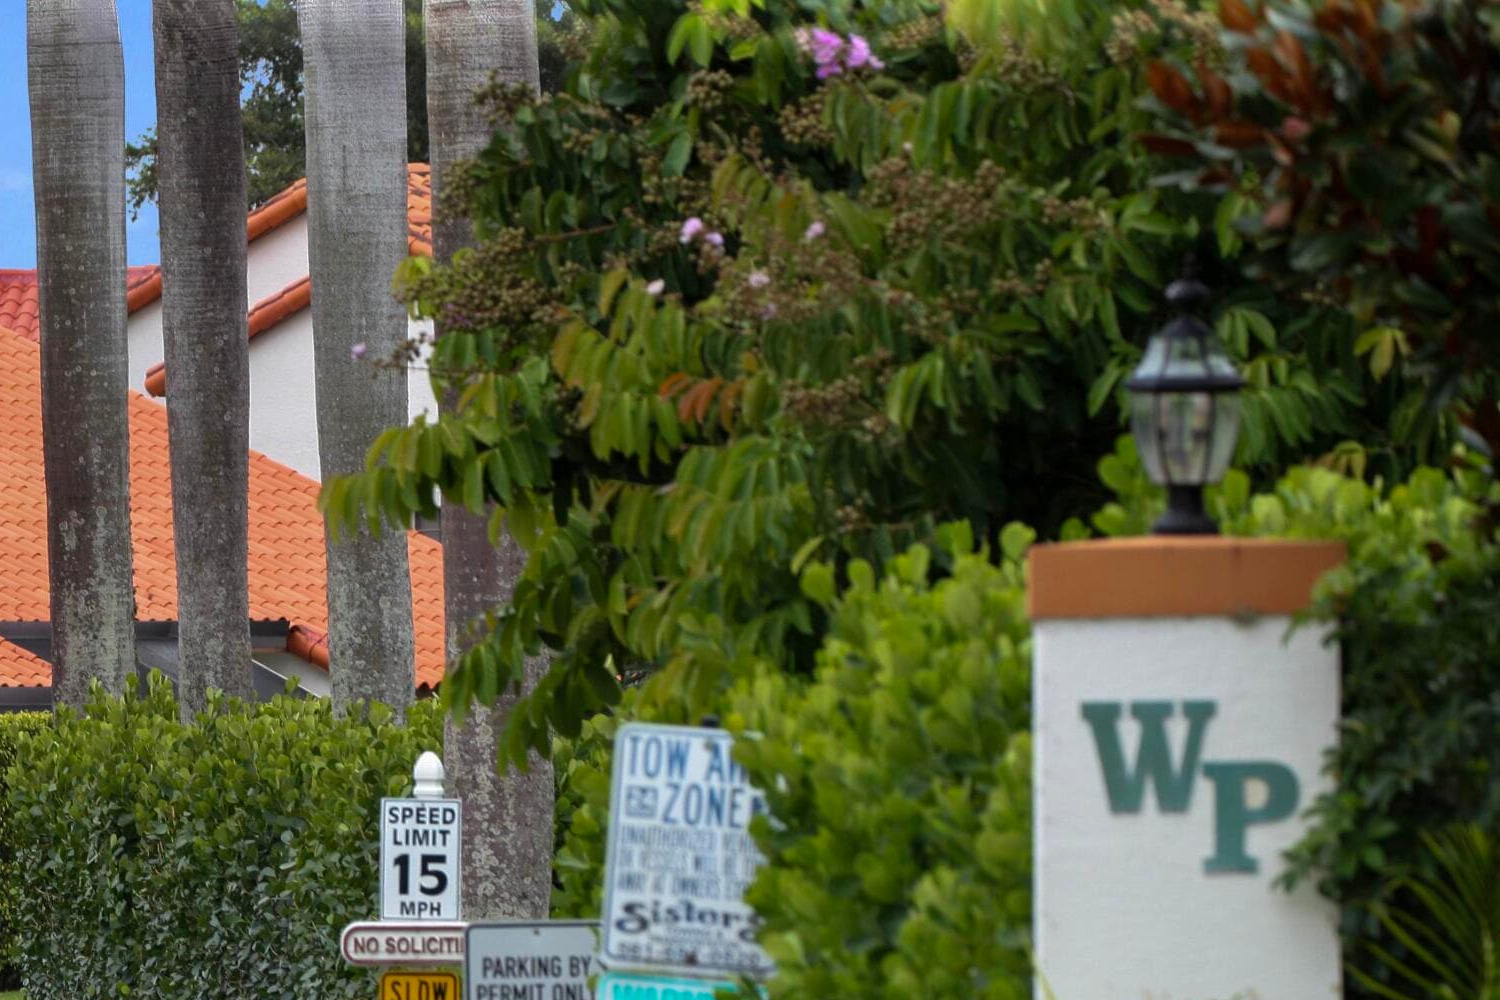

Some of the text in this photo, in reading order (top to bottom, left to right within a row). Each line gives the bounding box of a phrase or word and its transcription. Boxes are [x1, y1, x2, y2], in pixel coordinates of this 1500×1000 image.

[628, 735, 691, 779] TOW
[388, 806, 456, 825] SPEED
[662, 782, 744, 829] ZONE
[392, 828, 451, 847] LIMIT
[393, 853, 449, 897] 15
[400, 901, 442, 917] MPH
[353, 936, 465, 954] NO SOLICITI
[482, 955, 562, 978] PARKING
[569, 954, 592, 977] BY
